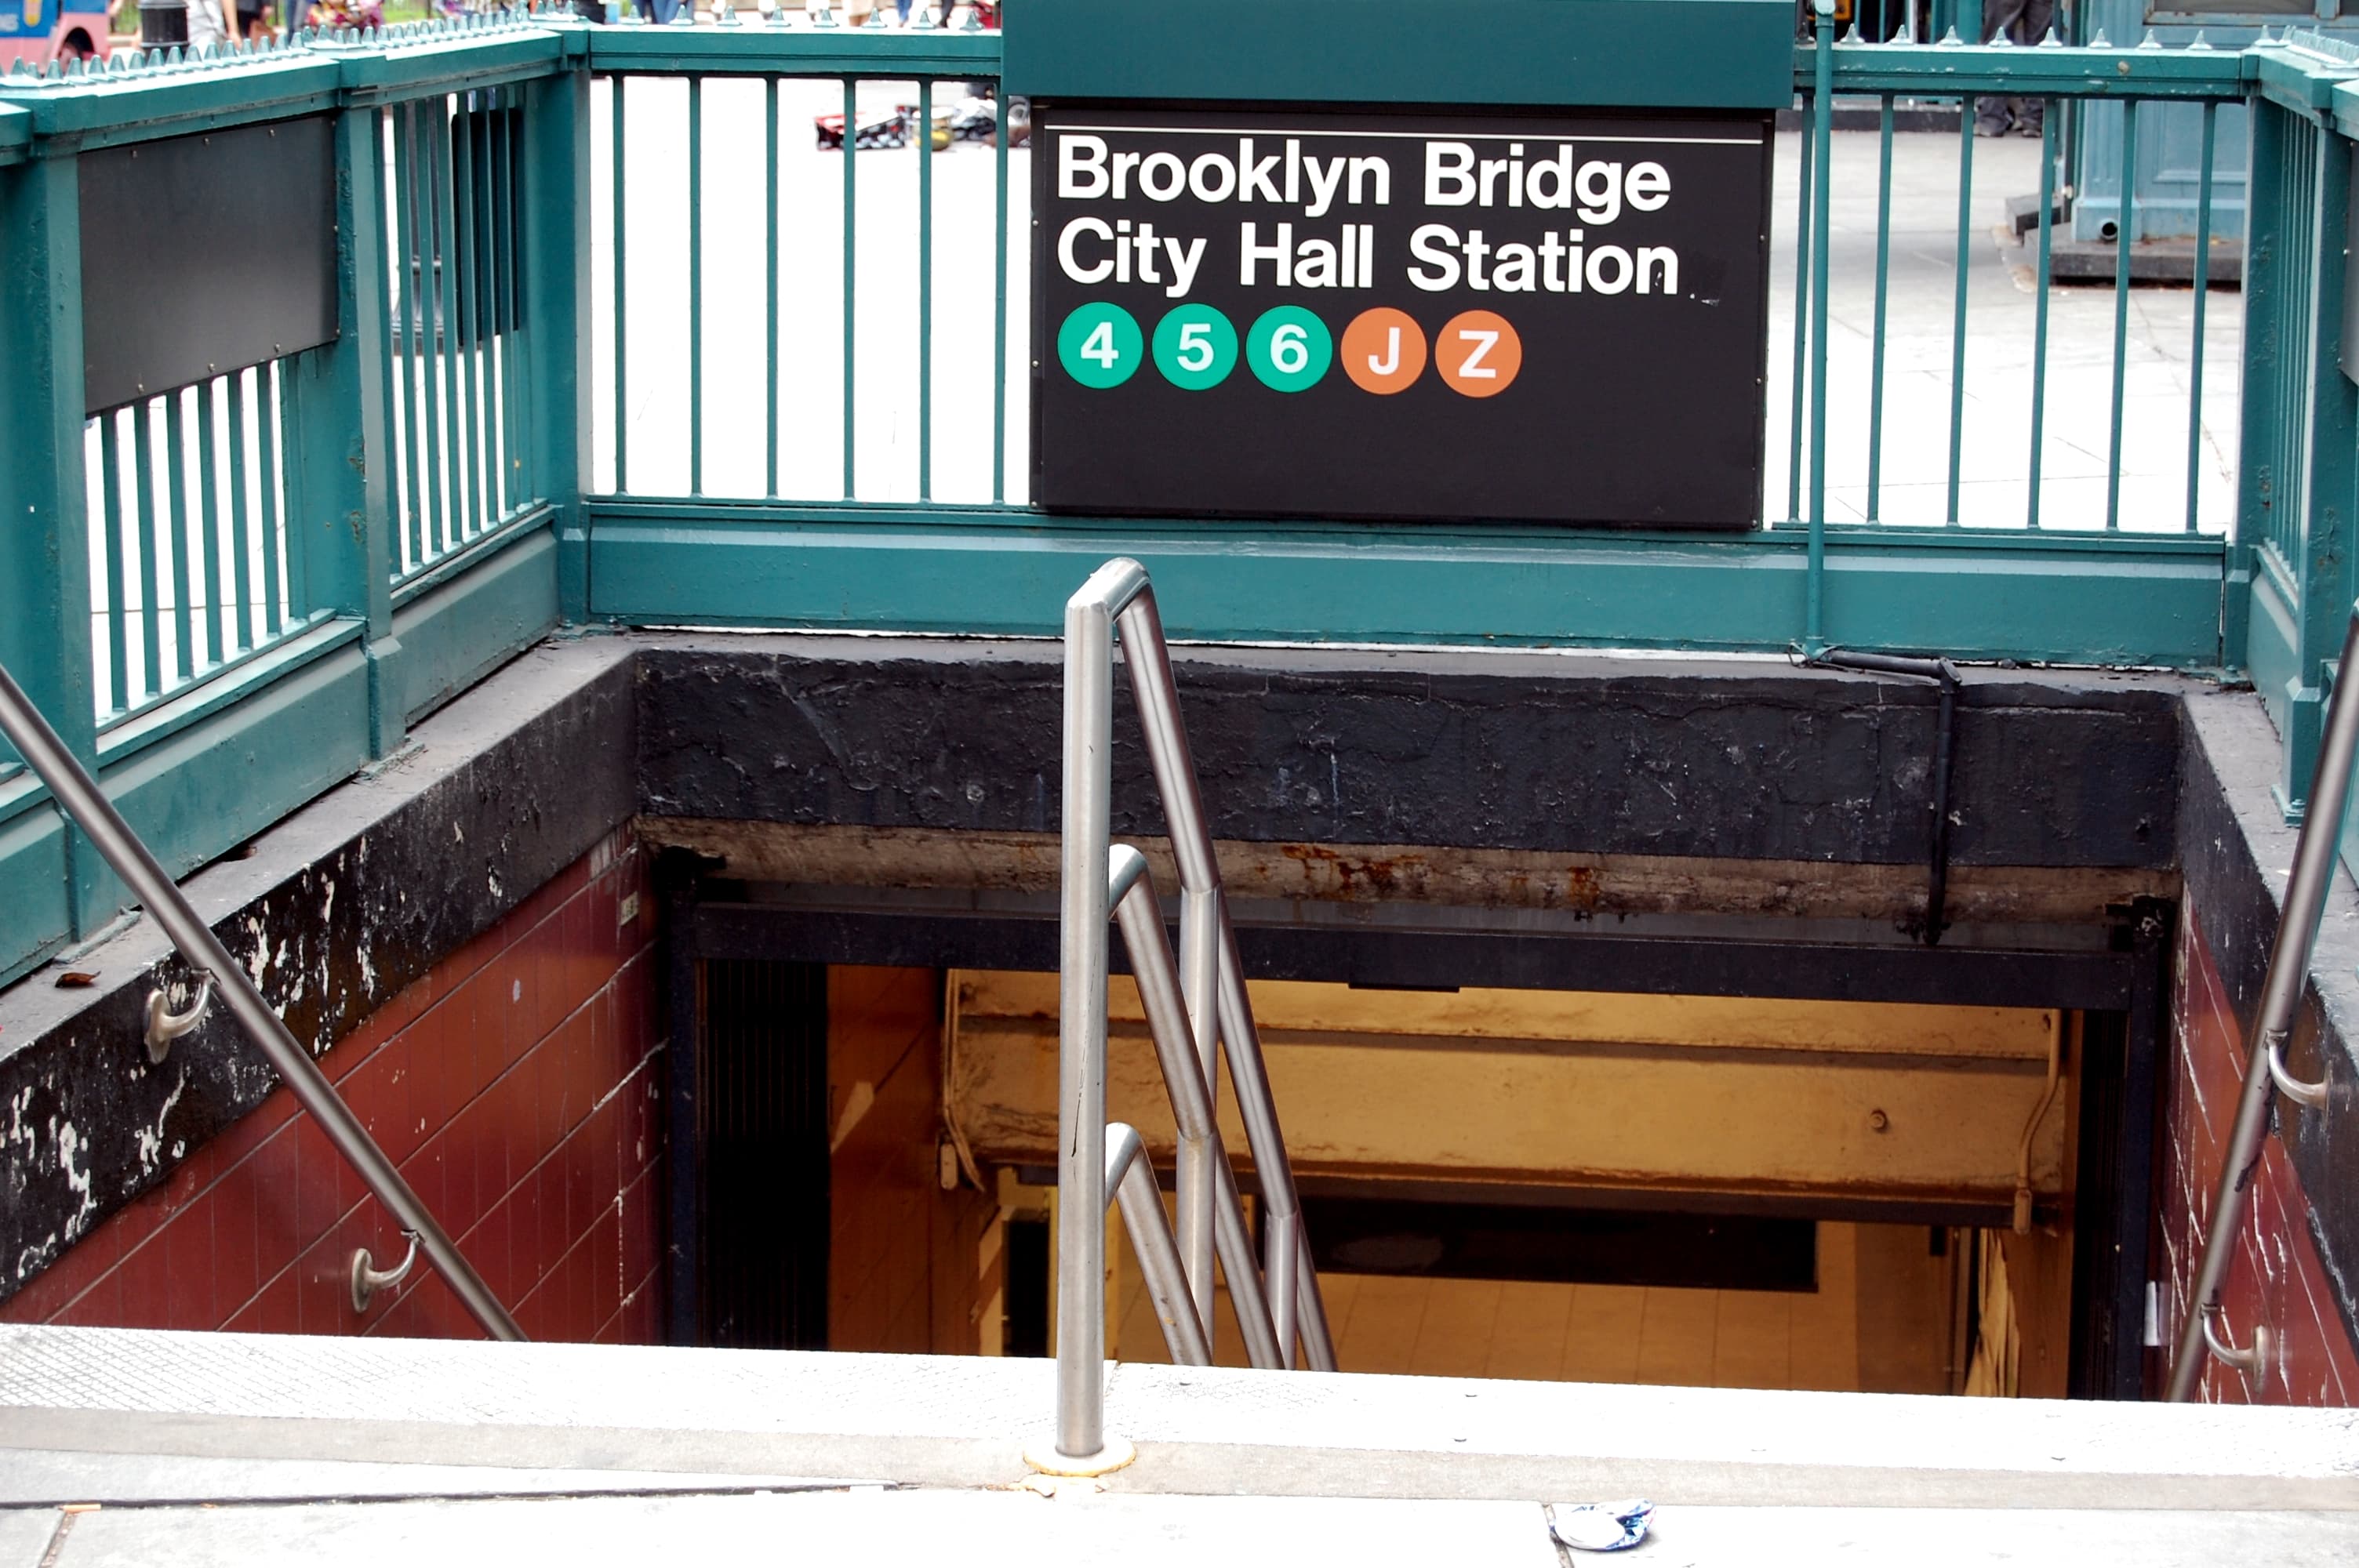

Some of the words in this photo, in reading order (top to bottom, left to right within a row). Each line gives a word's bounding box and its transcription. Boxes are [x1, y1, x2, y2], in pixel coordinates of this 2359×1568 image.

[1059, 135, 1390, 217] Brooklyn
[1425, 142, 1670, 225] Bridge
[1058, 217, 1207, 297] City
[1241, 222, 1373, 288] Hall
[1407, 224, 1678, 295] Station
[1080, 321, 1119, 368] 4
[1176, 323, 1214, 372] 5
[1270, 324, 1308, 373] 6
[1367, 326, 1401, 376] J
[1458, 329, 1499, 379] Z
